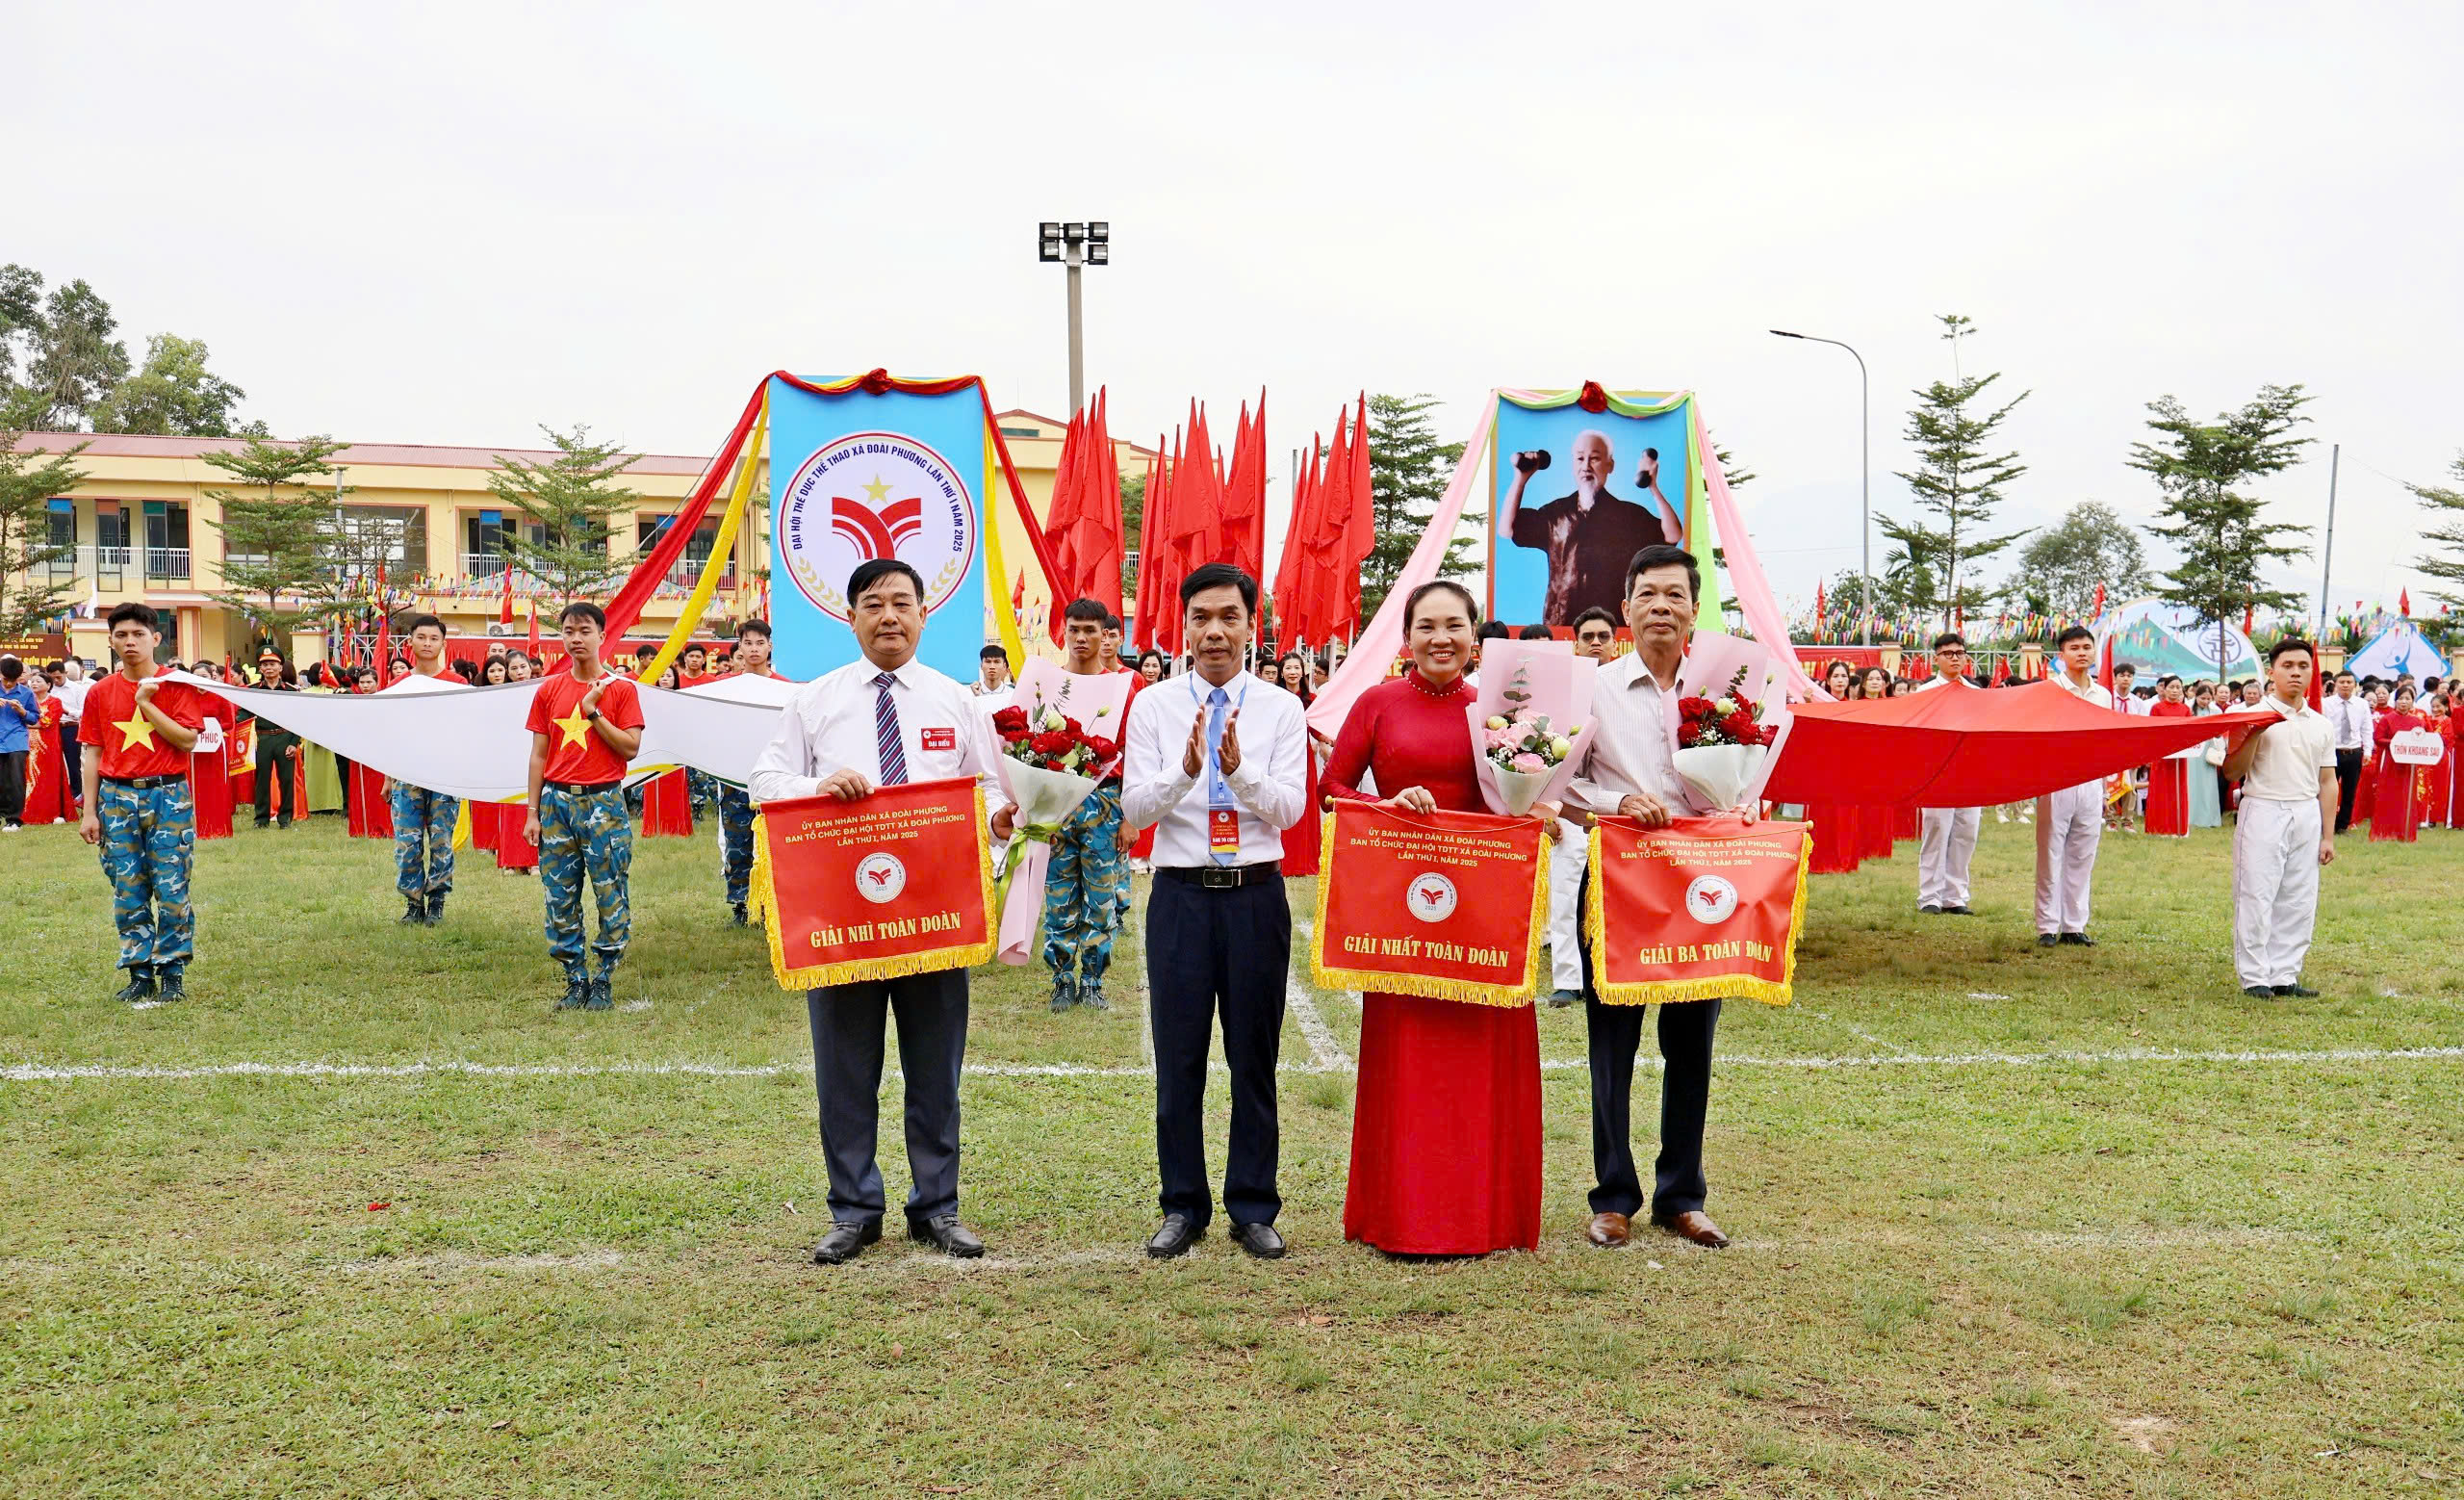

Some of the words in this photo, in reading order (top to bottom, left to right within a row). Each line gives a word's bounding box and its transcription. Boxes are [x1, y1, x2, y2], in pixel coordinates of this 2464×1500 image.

[827, 449, 850, 466] THAO
[852, 444, 865, 456] XÃ
[867, 443, 888, 453] ĐOÀI
[891, 446, 927, 468] PHƯƠNG
[811, 459, 829, 478] THỂ
[799, 477, 816, 496] DỤC
[940, 480, 956, 498] THỨ
[793, 494, 806, 513] THỂ
[789, 516, 803, 531] HỘI
[950, 504, 964, 527] NĂM
[791, 534, 804, 550] ĐẠI
[952, 530, 963, 552] 2025
[802, 821, 812, 830] ỦY
[815, 820, 833, 828] BAN
[835, 816, 858, 826] NHÂN
[860, 814, 877, 822] DÂN
[879, 811, 890, 820] XÃ
[892, 808, 911, 818] ĐOÀI
[913, 806, 948, 815] PHƯƠNG
[785, 835, 803, 843] BAN
[805, 829, 817, 840] TỔ
[818, 828, 841, 838] CHỨC
[843, 827, 858, 836] ĐẠI
[860, 824, 873, 834] HỘI
[875, 822, 895, 831] TDTT
[898, 819, 909, 828] XÃ
[911, 817, 930, 827] ĐOÀI
[932, 814, 965, 824] PHƯƠNG
[856, 834, 872, 844] THỨ
[880, 832, 898, 841] NĂM
[900, 831, 919, 839] 2025
[1369, 827, 1379, 836] ỦY
[1400, 830, 1423, 840] NHÂN
[1425, 833, 1442, 841] DÂN
[1457, 837, 1476, 846] ĐOÀI
[1477, 840, 1511, 849] PHƯƠNG
[1370, 837, 1380, 847] TỔ
[1382, 840, 1404, 849] CHỨC
[1406, 842, 1420, 851] ĐẠI
[1422, 843, 1436, 852] HỘI
[1437, 845, 1458, 854] TDTT
[1460, 847, 1470, 855] XÃ
[1472, 849, 1492, 858] ĐOÀI
[1493, 852, 1527, 862] PHƯƠNG
[1726, 840, 1745, 848] ĐOÀI
[1748, 841, 1782, 849] PHƯƠNG
[1440, 856, 1458, 865] NĂM
[1639, 849, 1650, 858] TỔ
[1652, 849, 1674, 858] CHỨC
[1766, 851, 1797, 861] PHƯƠNG
[810, 924, 844, 948] GIẢI
[847, 921, 874, 943] NHÌ
[877, 917, 917, 940] TOÀN
[921, 910, 961, 933] ĐOÀN
[1344, 932, 1377, 954] GIẢI
[1380, 934, 1421, 957] NHẤT
[1424, 940, 1464, 962] TOÀN
[1467, 946, 1509, 968] ĐOÀN
[1640, 943, 1673, 965] GIẢI
[1677, 945, 1699, 963] BA
[1702, 939, 1741, 961] TOÀN
